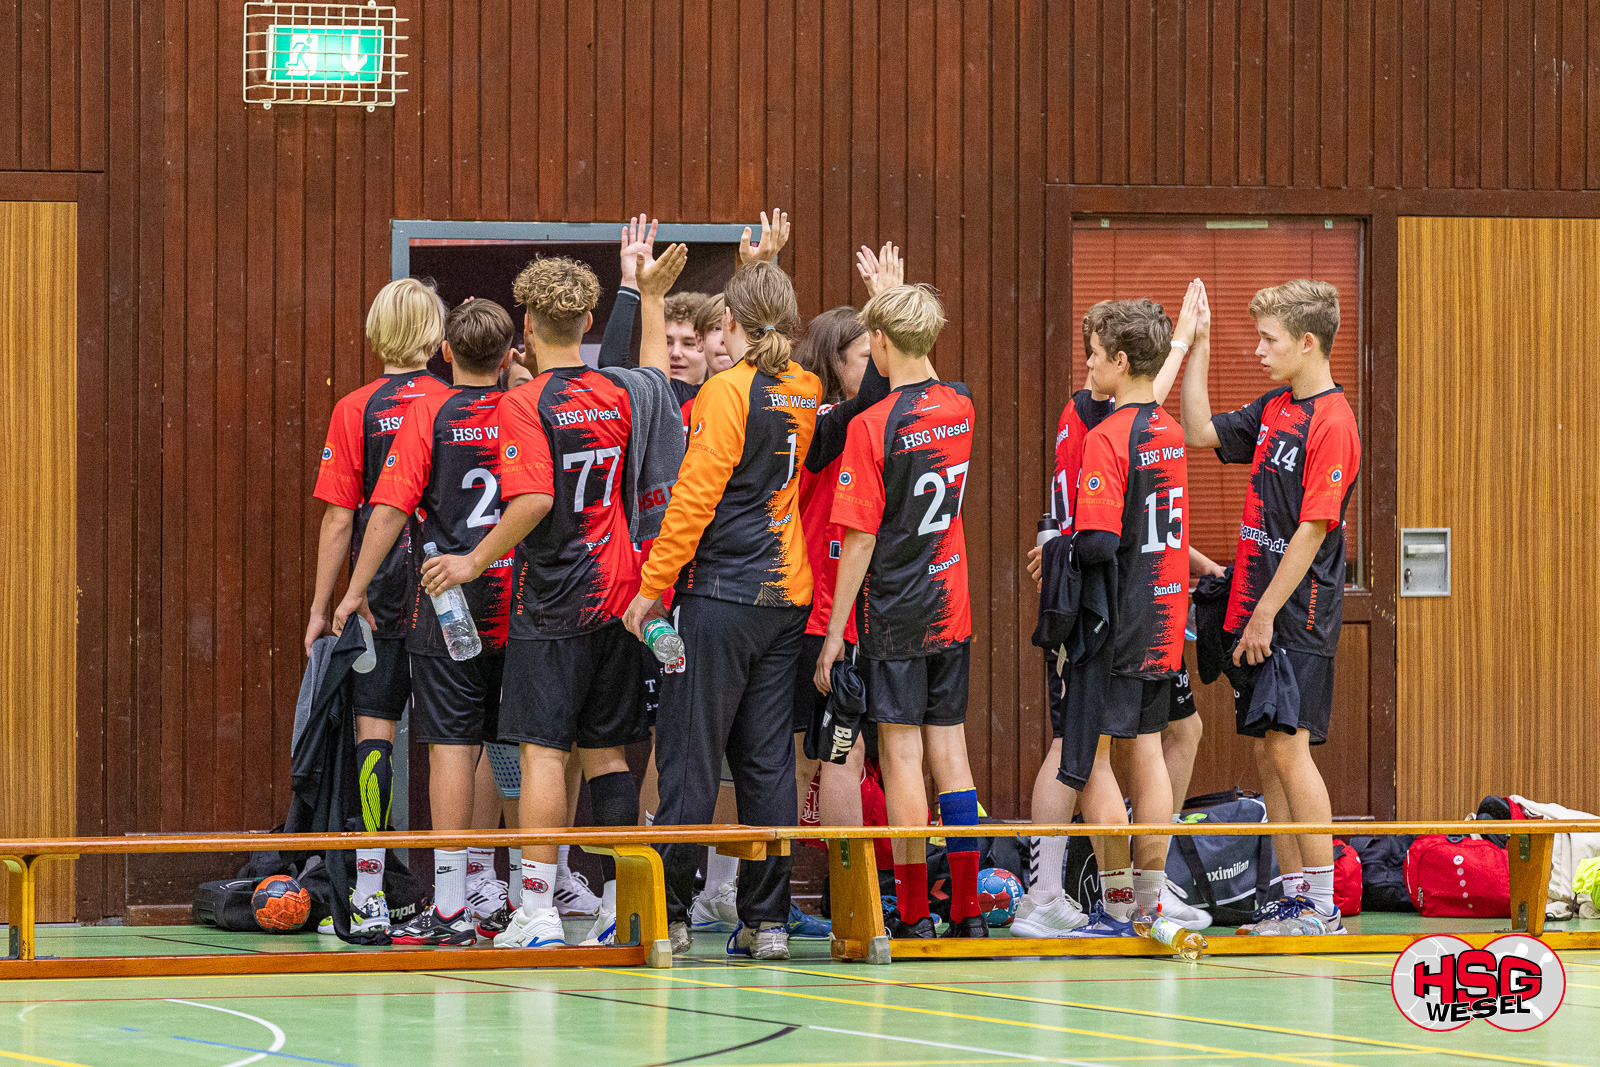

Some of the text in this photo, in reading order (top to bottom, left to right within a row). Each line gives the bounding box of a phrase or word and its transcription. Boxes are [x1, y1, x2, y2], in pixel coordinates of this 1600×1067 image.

[556, 406, 621, 426] HSG Wesel
[769, 394, 817, 409] HSG Wesel
[452, 427, 483, 442] HSG
[901, 417, 970, 450] HSG Wesel
[781, 433, 797, 490] 1
[1139, 446, 1184, 466] HSG Wese
[1270, 440, 1299, 473] 14
[562, 445, 622, 513] 77
[637, 488, 667, 513] HSG
[913, 459, 970, 537] 27
[1141, 486, 1183, 554] 15
[1107, 889, 1133, 900] HSG
